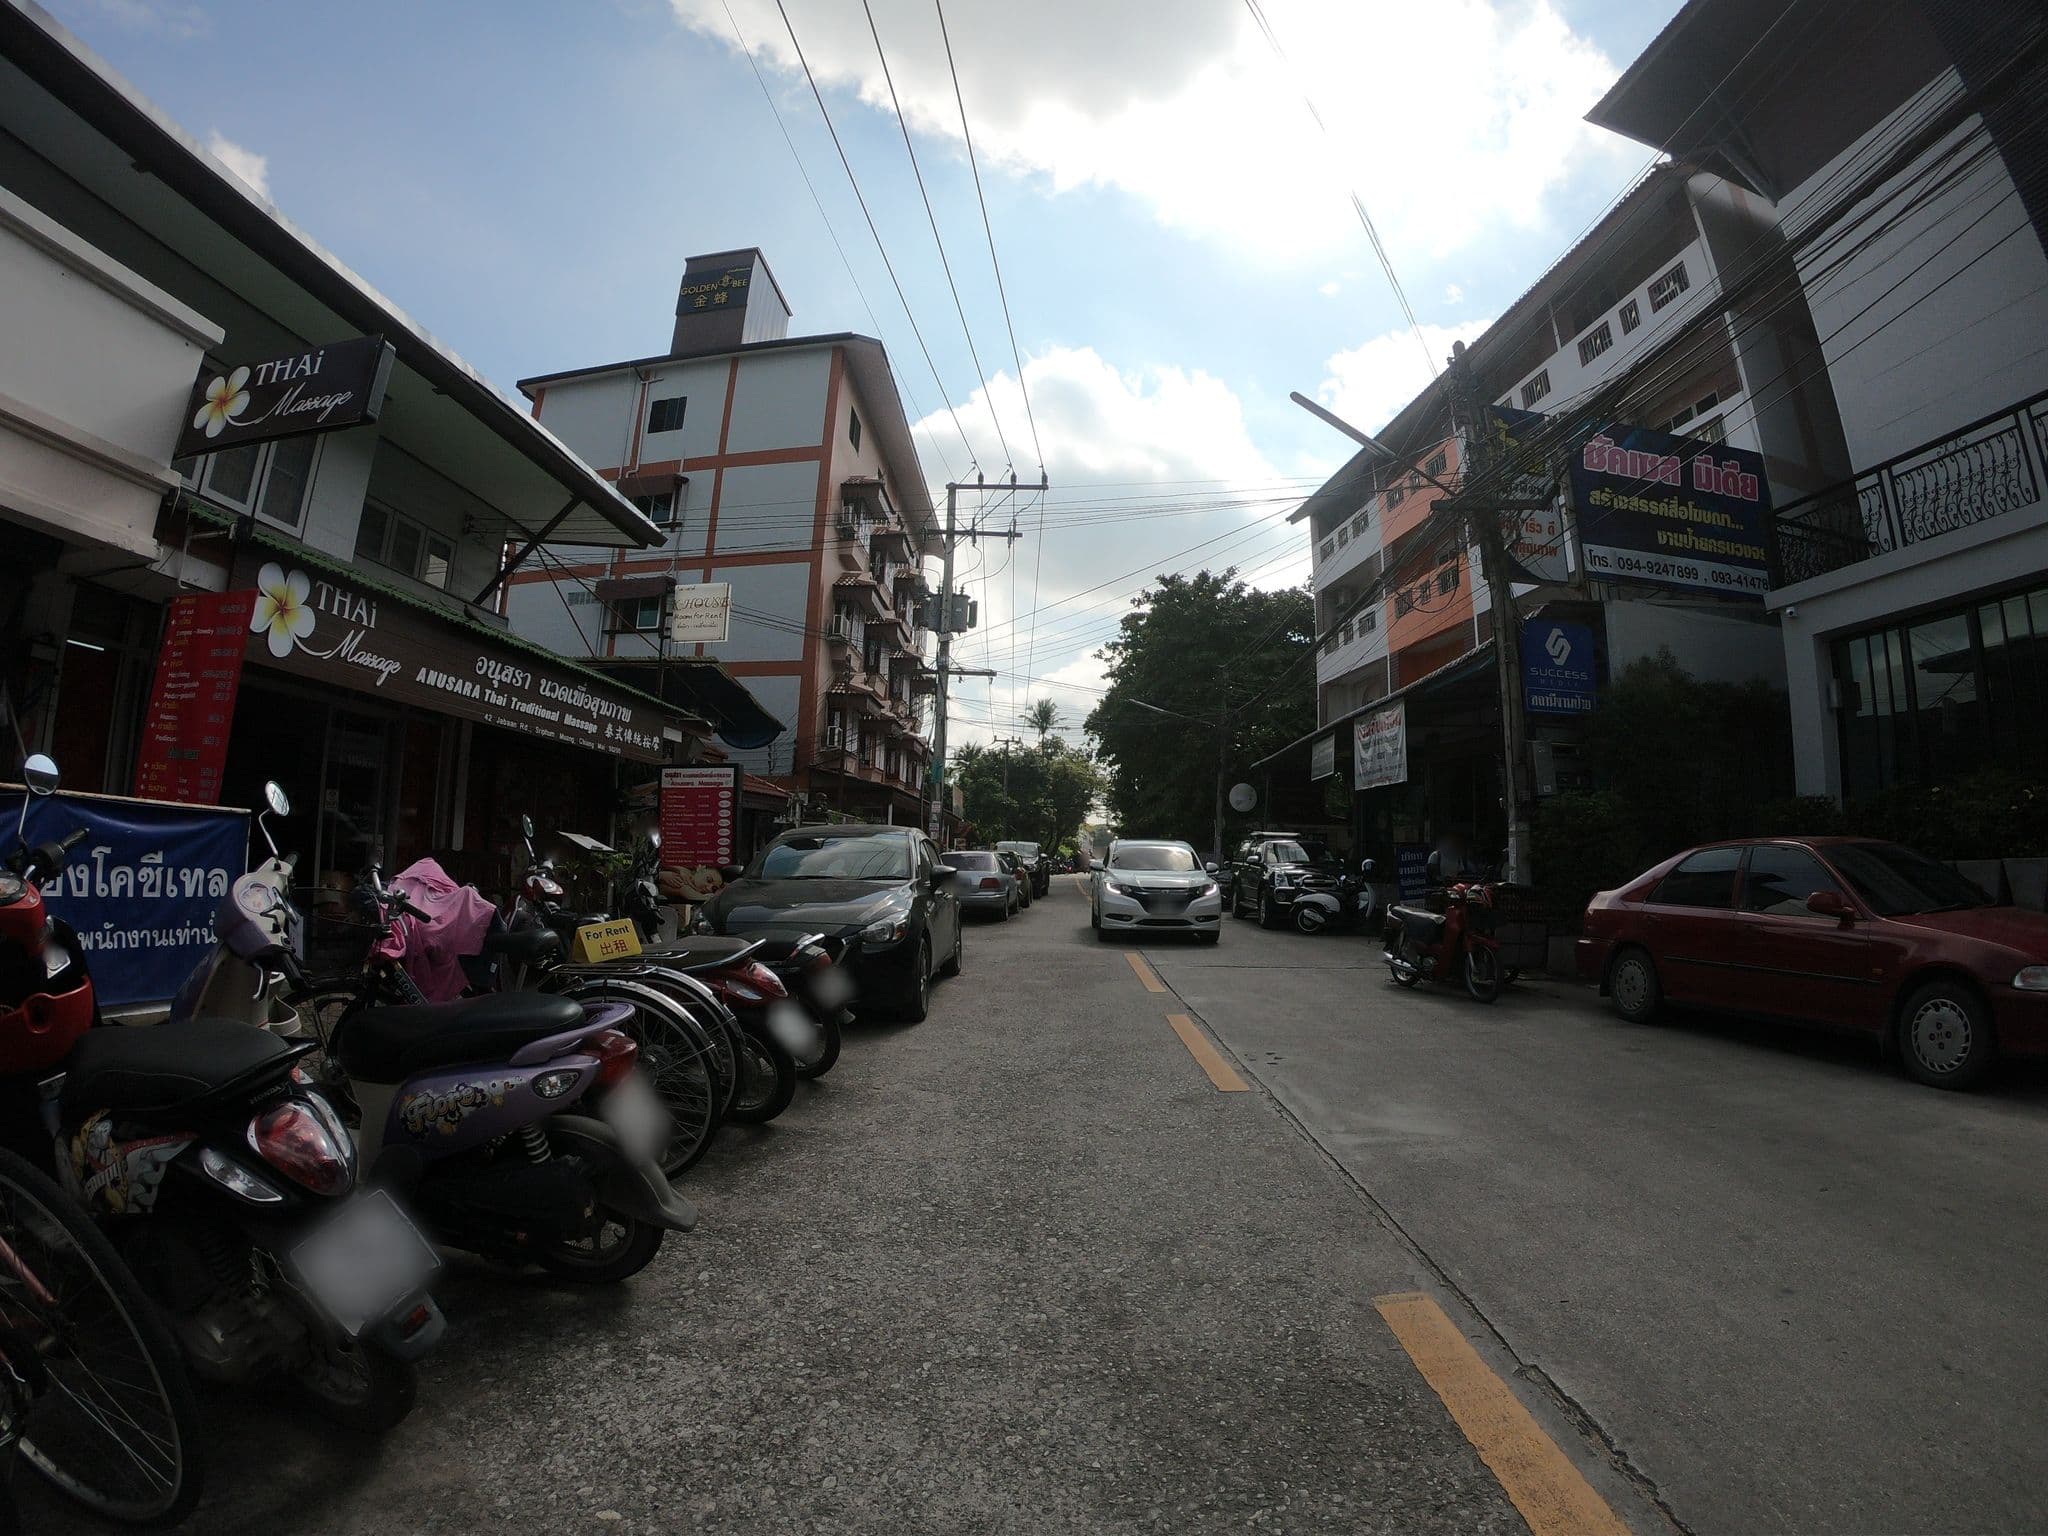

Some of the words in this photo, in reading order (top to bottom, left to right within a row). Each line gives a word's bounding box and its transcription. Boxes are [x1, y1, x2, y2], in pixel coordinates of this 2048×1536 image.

[681, 284, 718, 296] GOLDEN
[732, 279, 748, 288] BEE
[270, 382, 355, 423] Massage
[1618, 555, 1699, 582] 094-9247899
[328, 629, 402, 686] Massage
[475, 656, 532, 690] อนุสรา
[1529, 667, 1590, 681] SUCCESS
[416, 667, 480, 700] ANUSARA
[484, 689, 508, 707] Thai
[511, 697, 560, 722] Traditional
[564, 713, 599, 735] Massage
[585, 931, 603, 941] For
[605, 926, 630, 937] Rent
[600, 939, 629, 955] 出租
